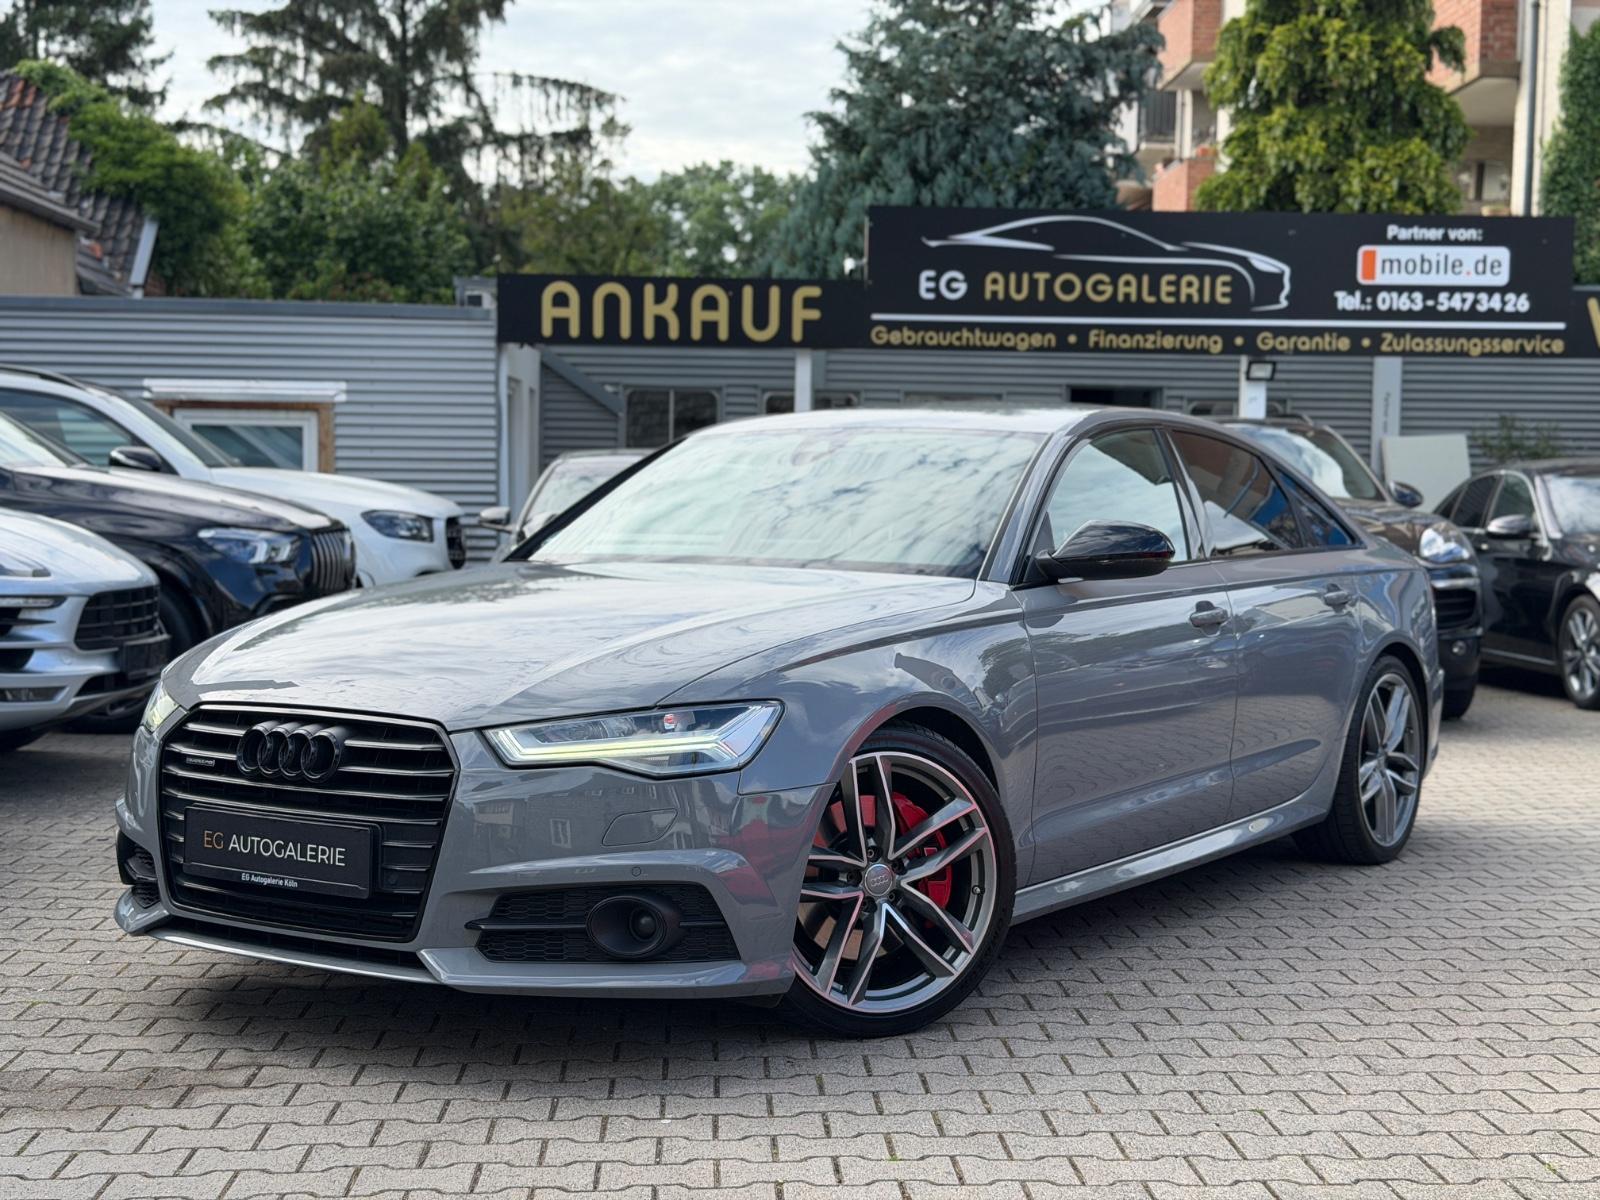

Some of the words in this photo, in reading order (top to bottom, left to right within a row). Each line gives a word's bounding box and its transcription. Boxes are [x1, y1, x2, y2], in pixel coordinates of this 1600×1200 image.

[1386, 224, 1445, 240] Partner
[1447, 227, 1483, 242] von:
[1381, 253, 1503, 276] mobile.de
[918, 270, 968, 300] EG
[984, 272, 1233, 305] AUTOGALERIE
[1334, 290, 1372, 311] Tel.:
[540, 280, 822, 343] ANKAUF
[870, 325, 1057, 351] Gebrauchtwagen
[1088, 329, 1223, 354] Finanzierung
[1256, 332, 1351, 352] Garantie
[1380, 333, 1565, 356] Zulassungsservice
[203, 830, 224, 849] EG
[228, 834, 346, 866] AUTOGALERIE
[241, 873, 250, 881] EG
[250, 874, 284, 886] Autogalerie
[284, 878, 298, 888] Köln
